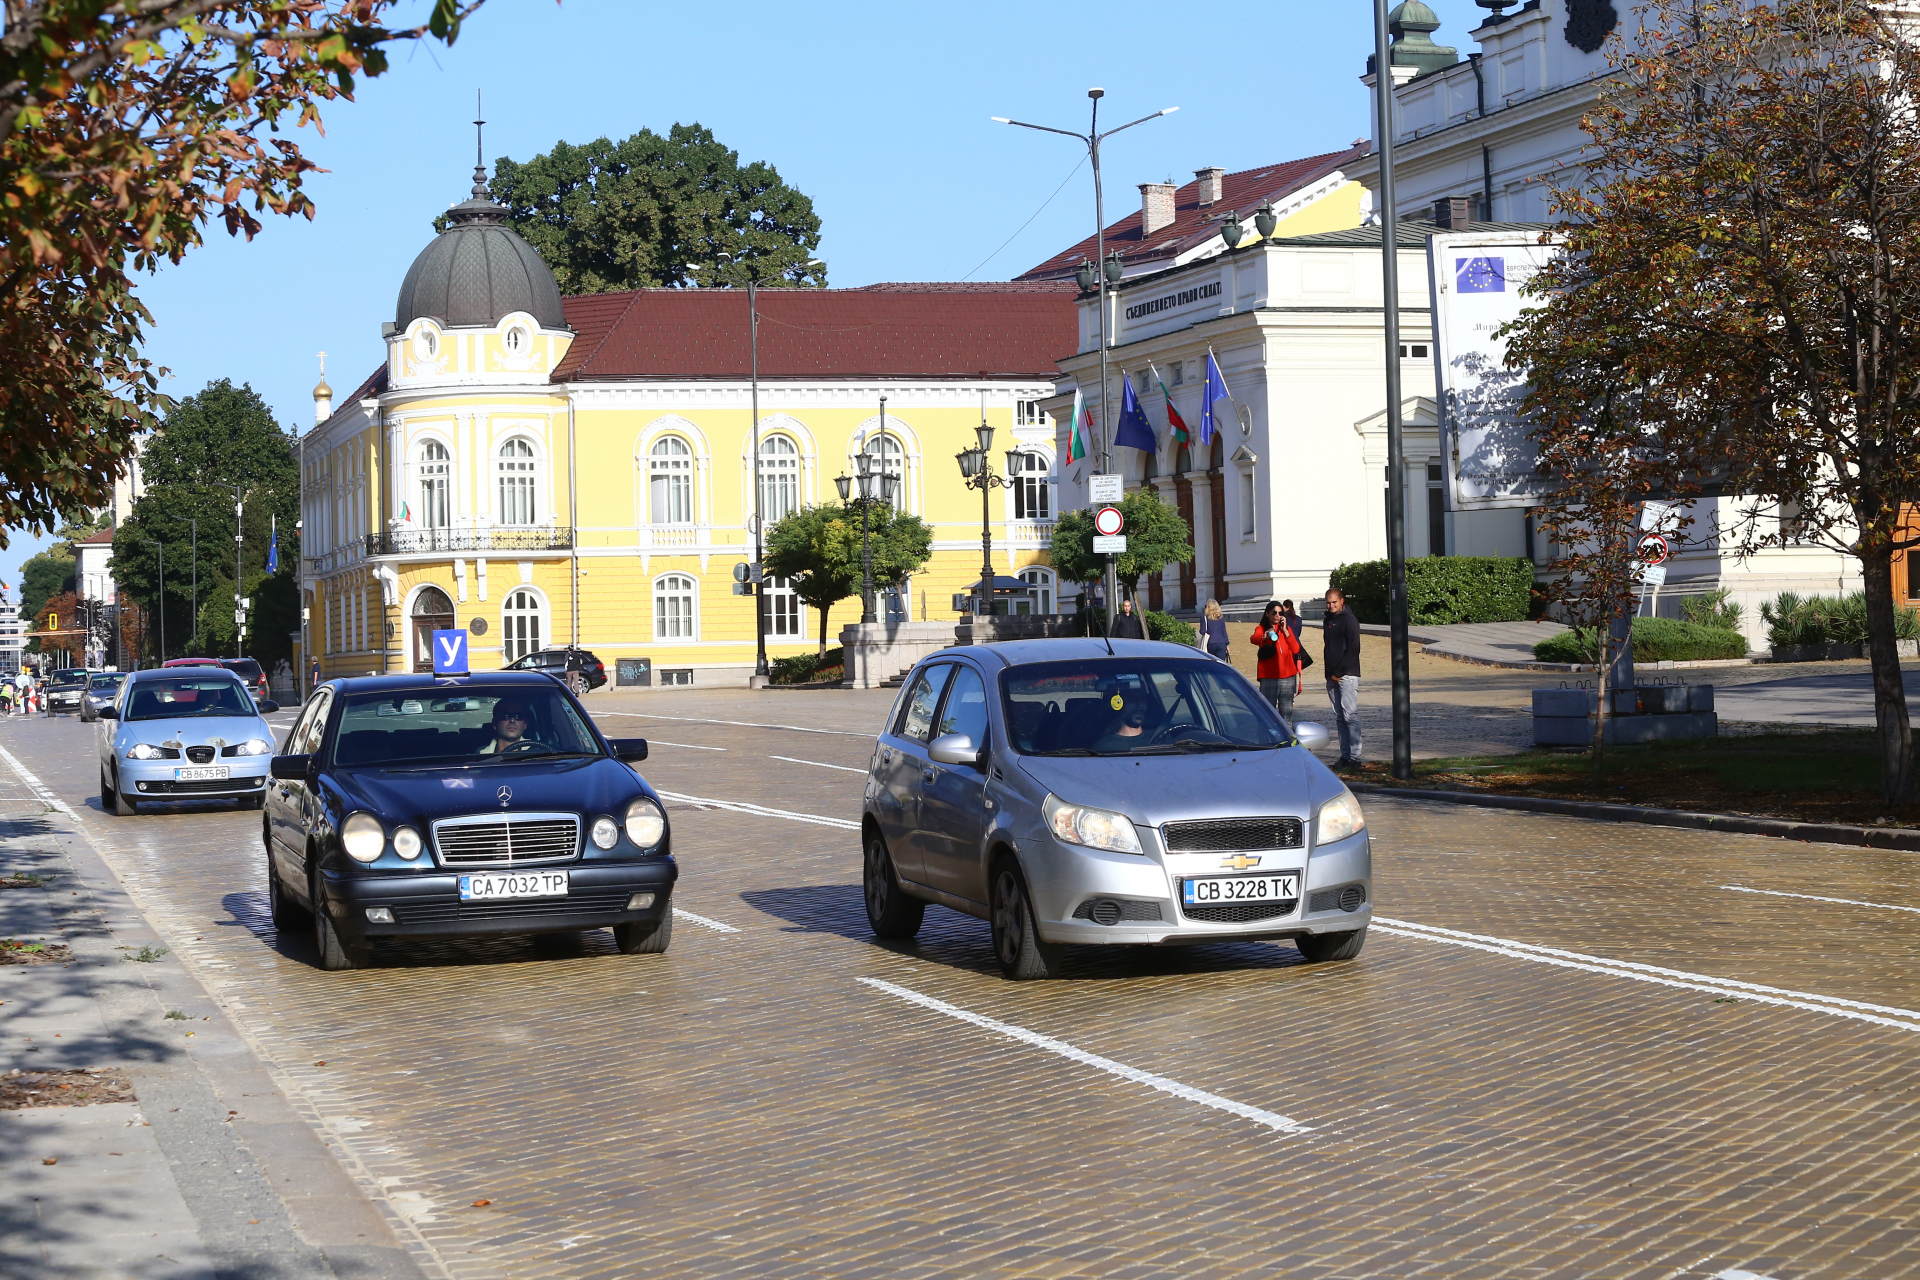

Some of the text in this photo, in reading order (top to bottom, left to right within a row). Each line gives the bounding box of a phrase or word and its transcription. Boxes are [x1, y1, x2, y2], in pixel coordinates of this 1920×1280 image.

[1125, 294, 1177, 320] СЪЕДИНЕНИЕТО
[1177, 287, 1198, 307] ПРАВИ
[181, 770, 192, 779] CB
[194, 770, 214, 778] 8675
[215, 769, 227, 778] PB
[472, 874, 564, 895] CA 7032 TP
[1197, 878, 1293, 900] CB 3228 TK
